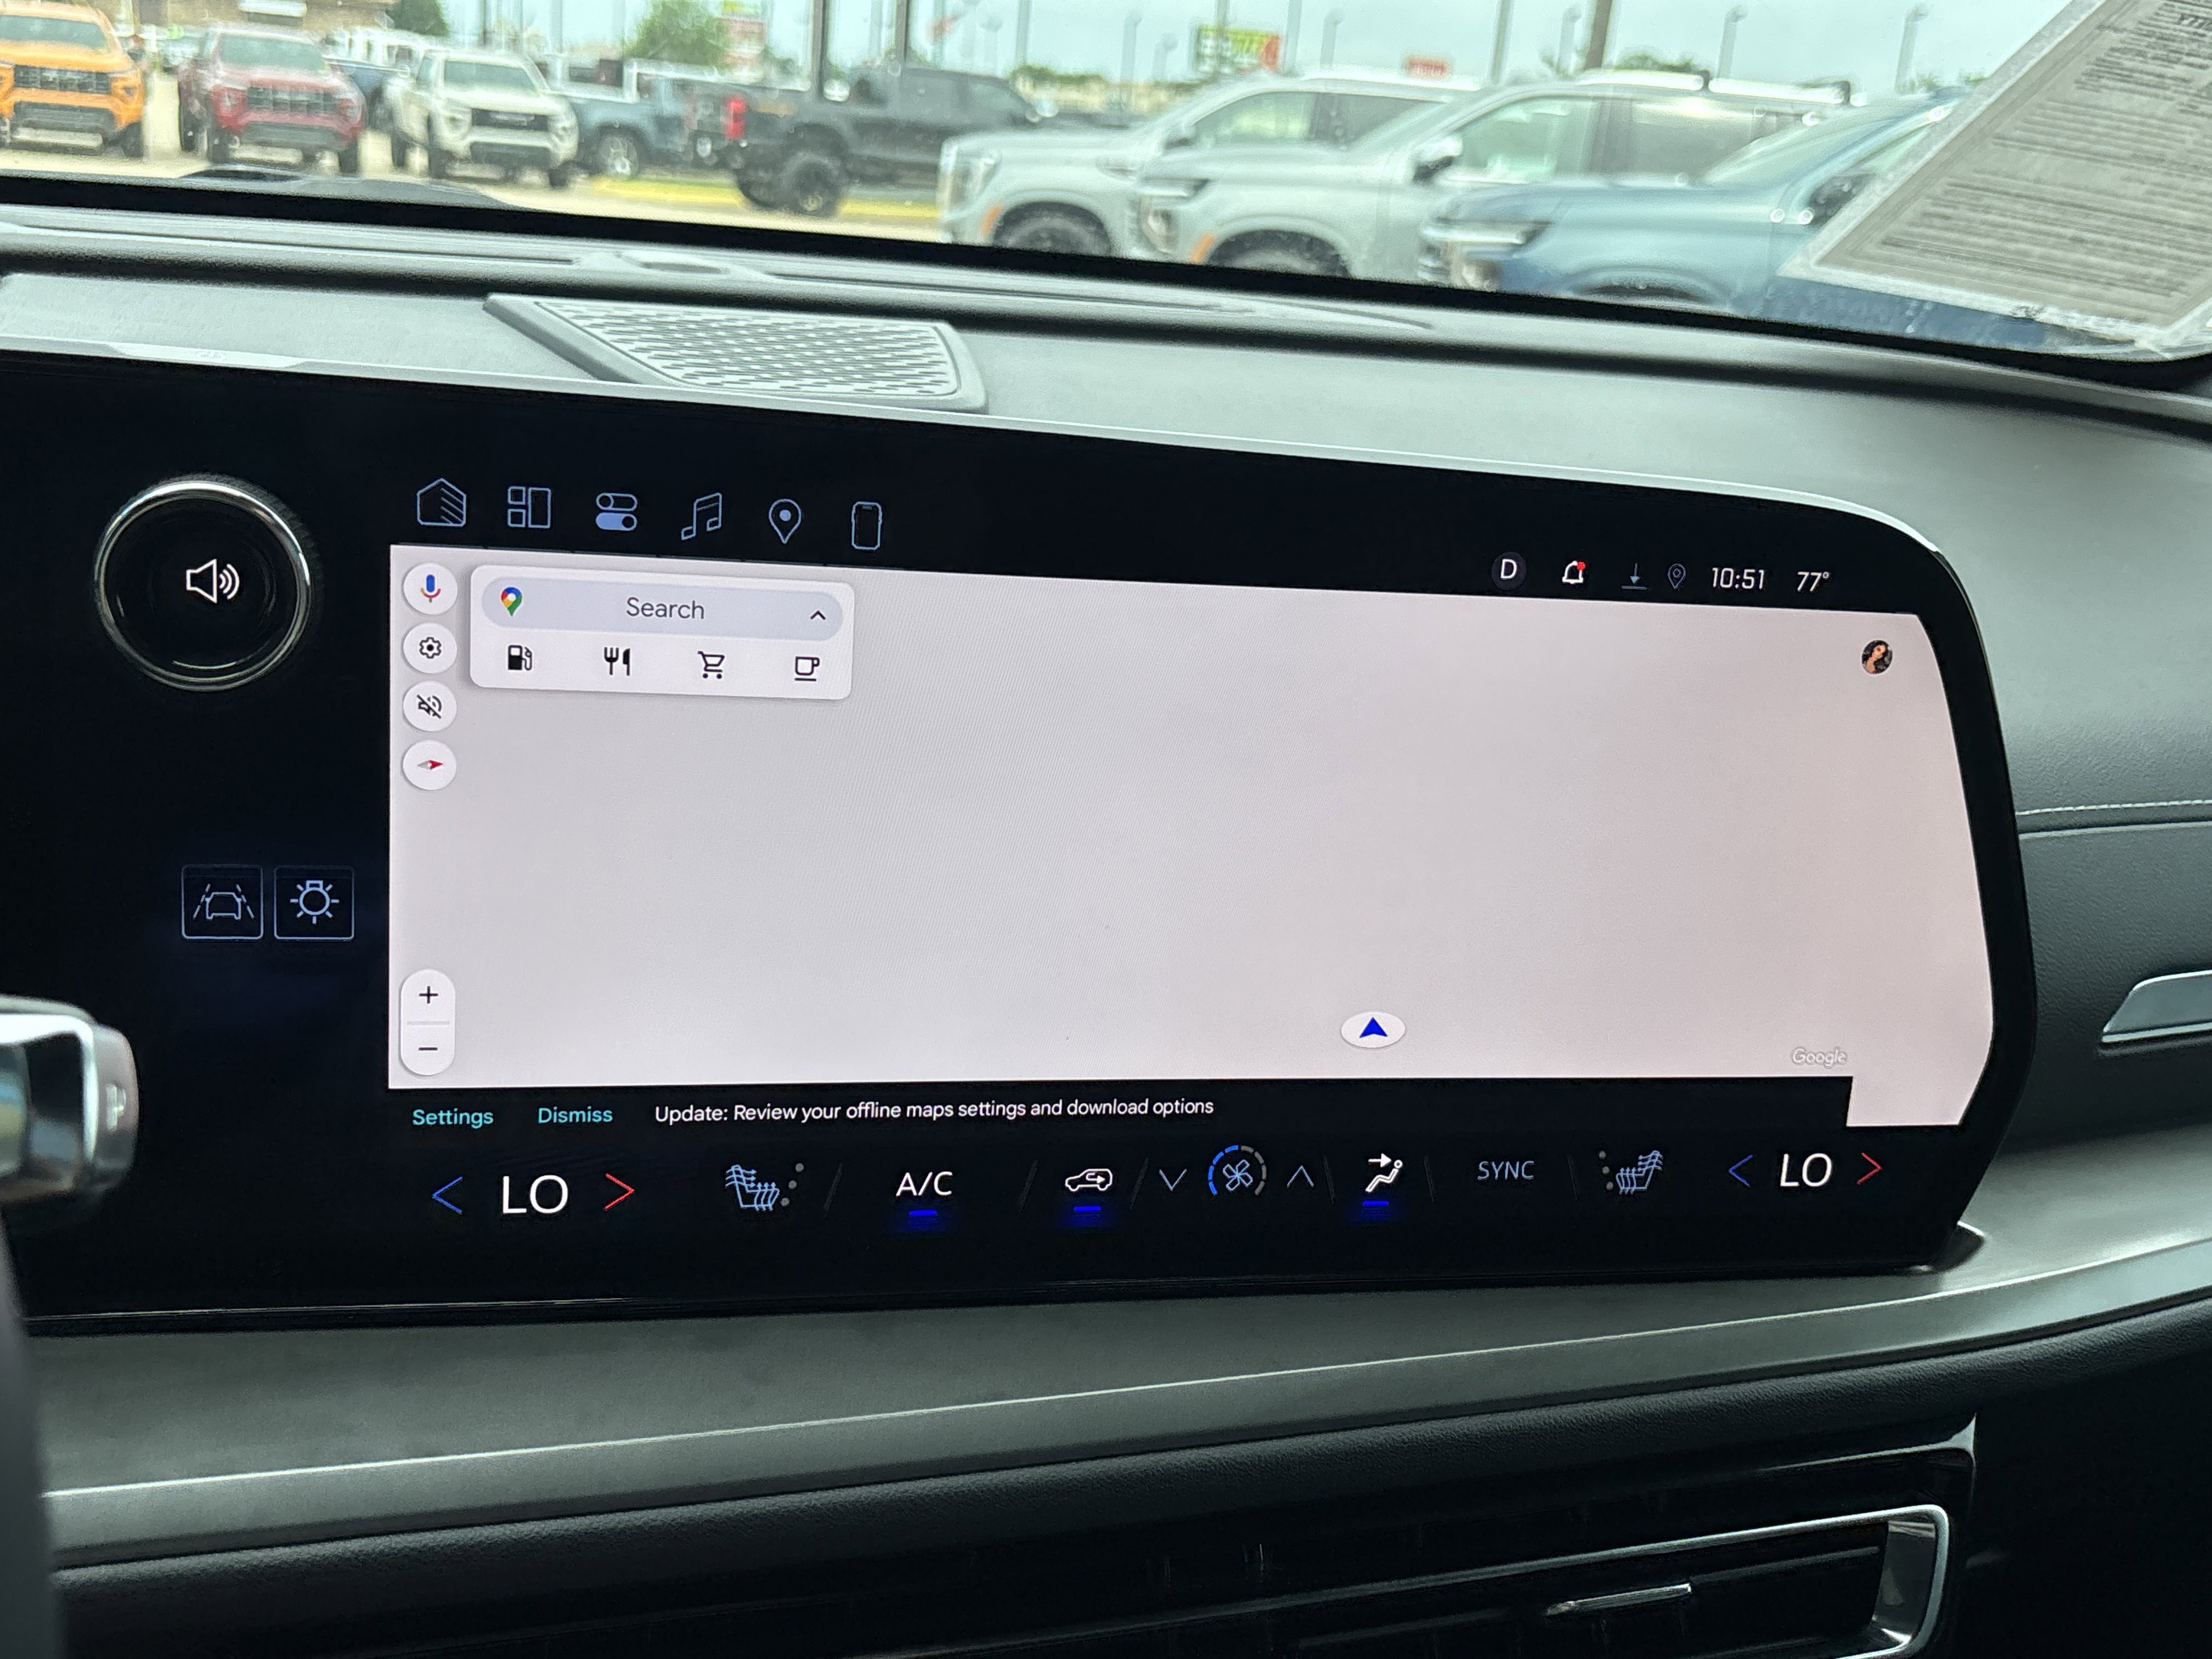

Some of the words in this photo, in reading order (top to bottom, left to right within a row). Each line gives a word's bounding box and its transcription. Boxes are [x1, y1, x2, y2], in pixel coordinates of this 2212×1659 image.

[1500, 558, 1518, 579] D
[1711, 566, 1765, 590] 10:51
[1797, 571, 1831, 593] 77°
[625, 596, 705, 620] Search
[1791, 1047, 1847, 1068] Google
[412, 1107, 494, 1129] Settings
[537, 1105, 614, 1124] Dismiss
[655, 1104, 729, 1126] Update:
[733, 1102, 799, 1121] Review
[800, 1105, 842, 1124] your
[845, 1101, 902, 1120] offline
[906, 1104, 955, 1121] maps
[957, 1099, 1027, 1121] settings
[1030, 1098, 1063, 1116] and
[1066, 1097, 1149, 1116] download
[1152, 1097, 1215, 1118] options
[1477, 1159, 1535, 1181] SYNC
[1779, 1152, 1832, 1188] LO
[501, 1173, 569, 1216] LO
[895, 1170, 954, 1198] A/C
